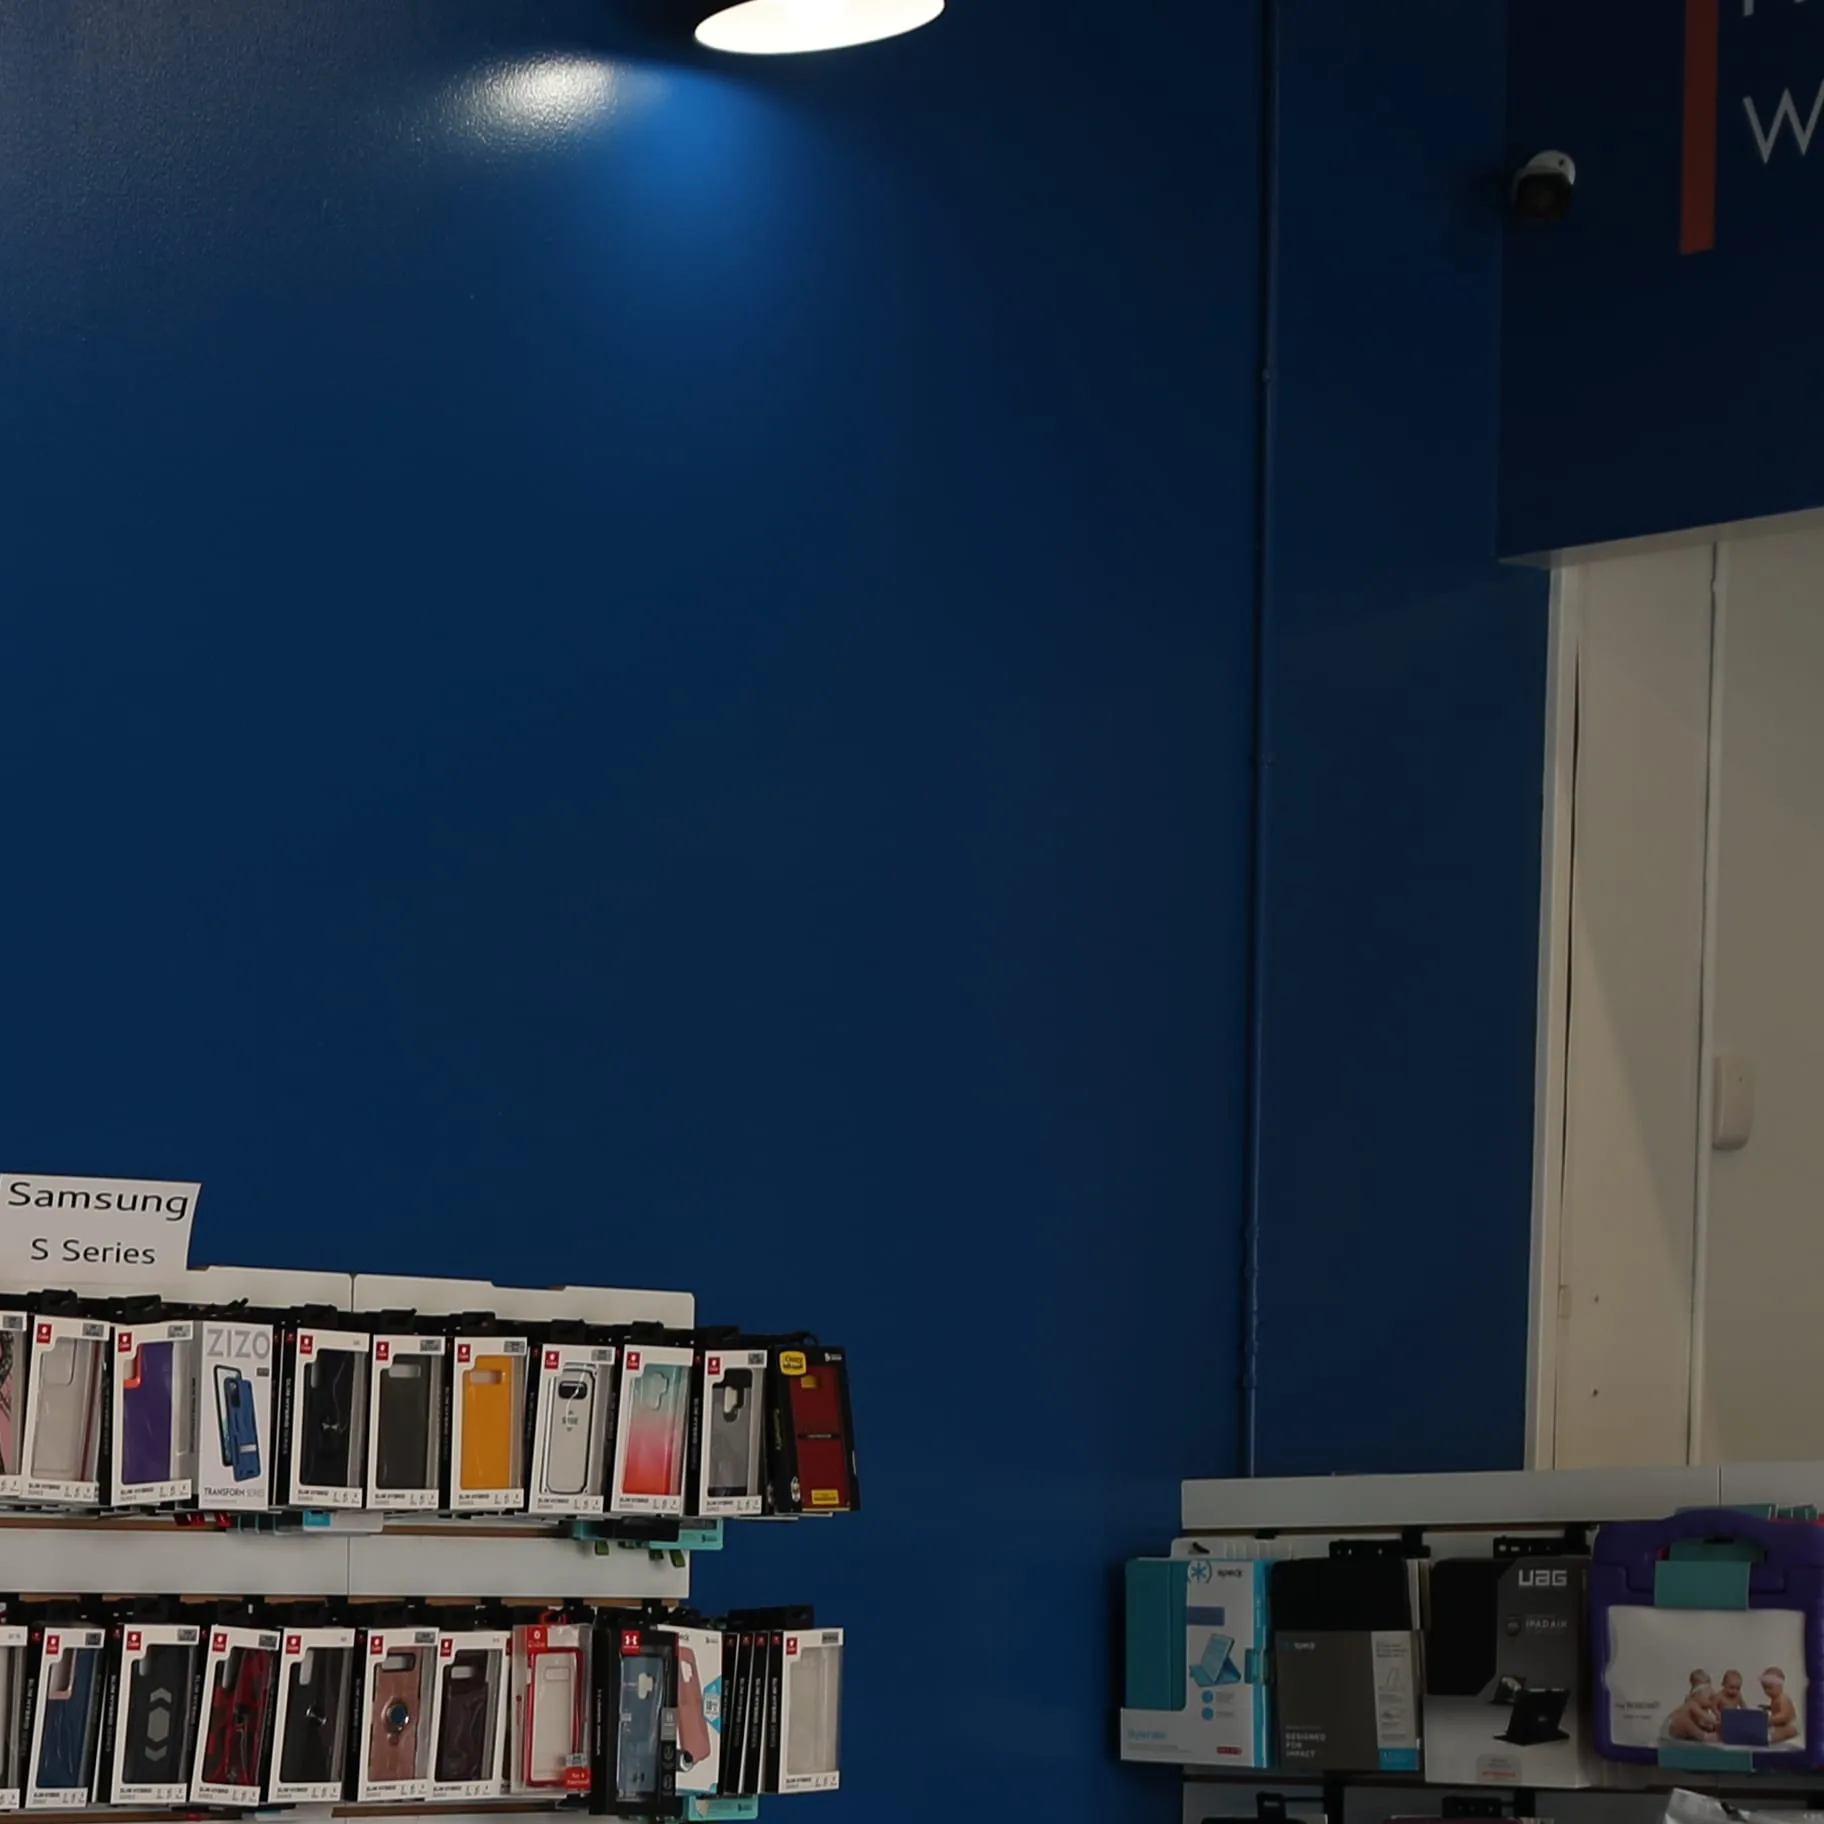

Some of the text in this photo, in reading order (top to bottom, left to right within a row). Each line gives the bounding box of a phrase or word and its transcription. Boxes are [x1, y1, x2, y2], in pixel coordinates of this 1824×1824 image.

[8, 1181, 189, 1221] Samsung
[31, 1238, 155, 1265] S Series
[206, 1328, 271, 1359] ZIZO
[1285, 1733, 1327, 1742] DESIGNED
[1285, 1749, 1316, 1758] IMPACT
